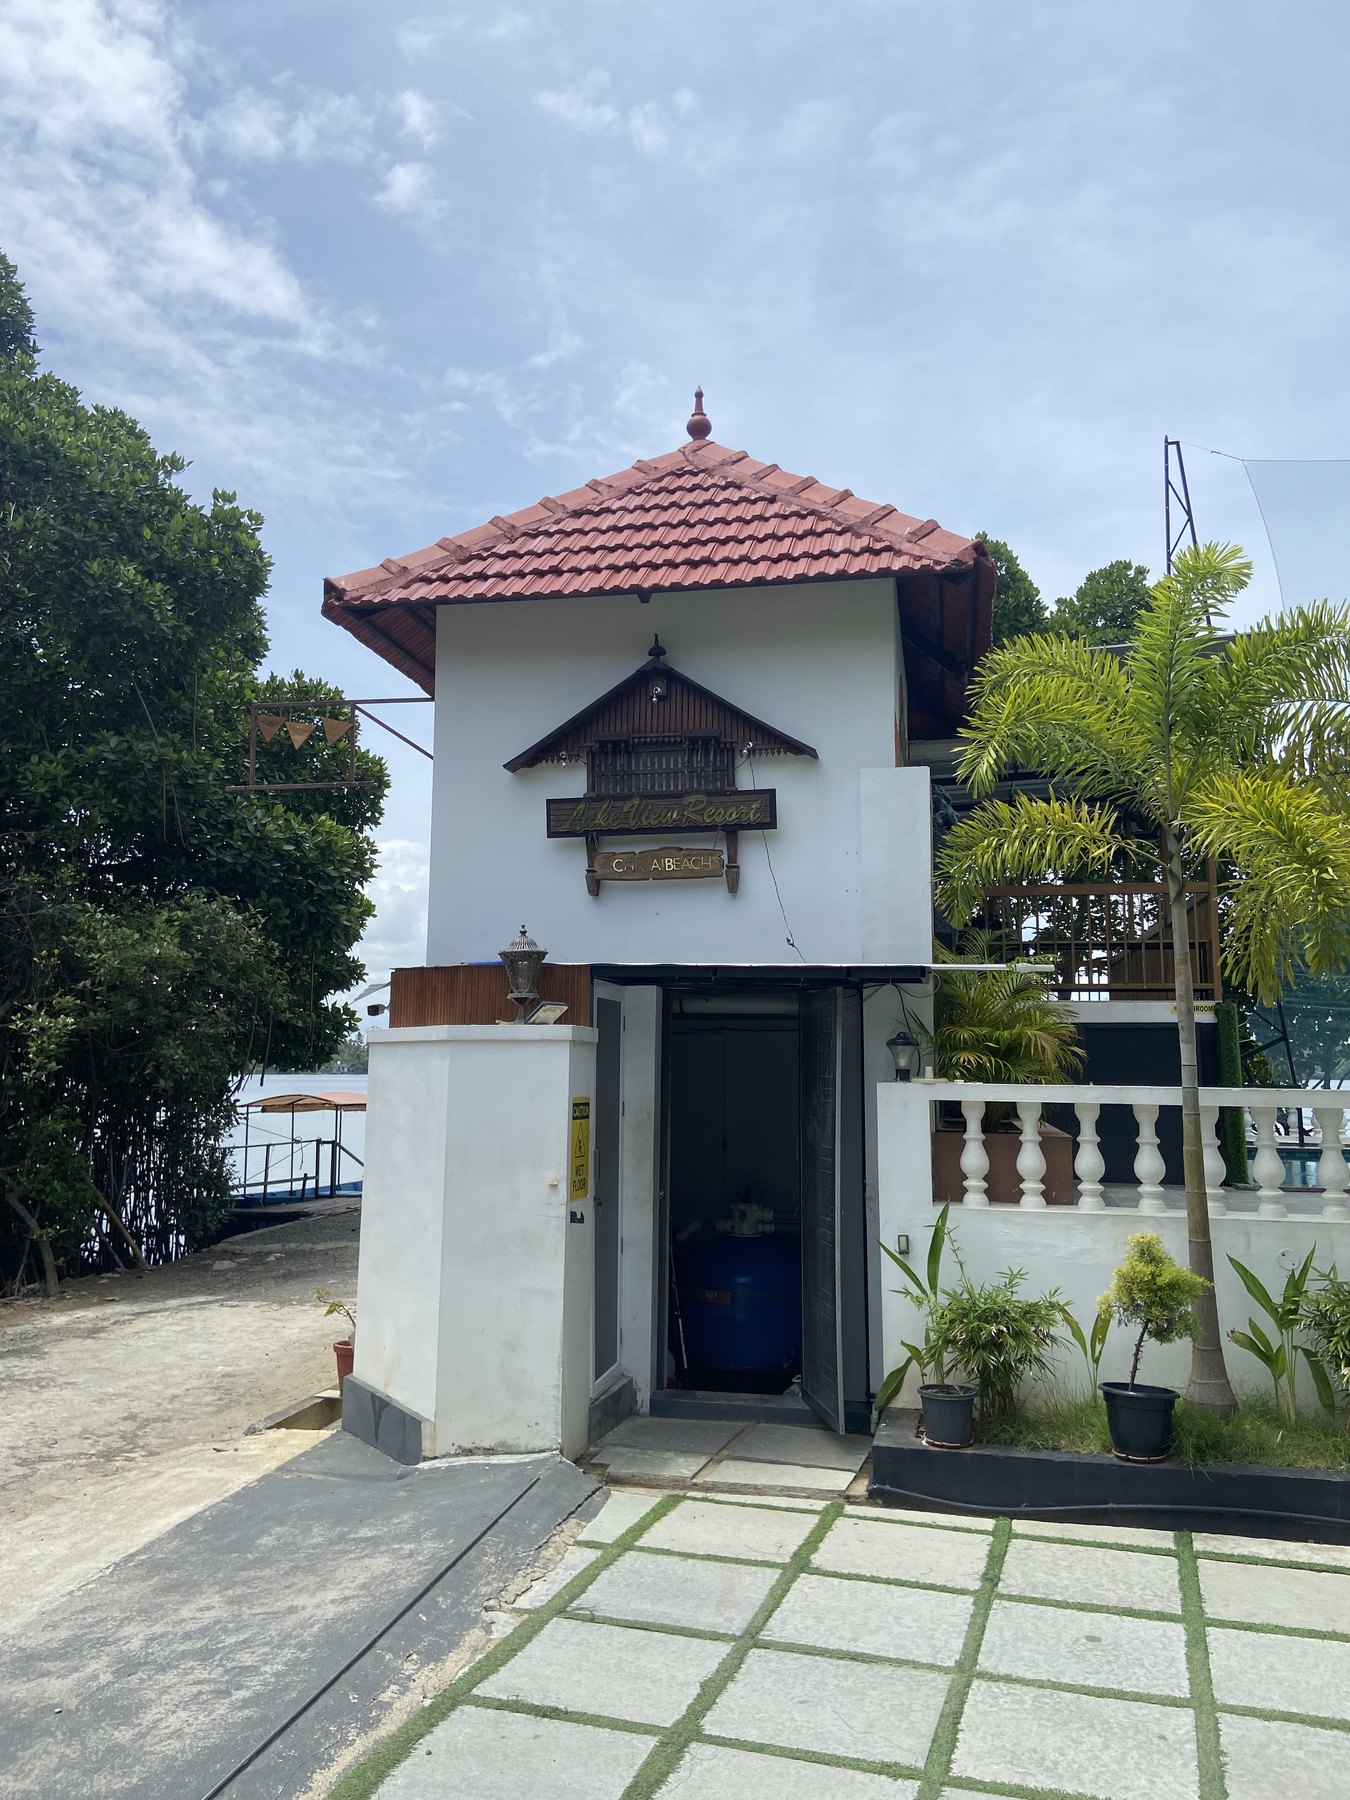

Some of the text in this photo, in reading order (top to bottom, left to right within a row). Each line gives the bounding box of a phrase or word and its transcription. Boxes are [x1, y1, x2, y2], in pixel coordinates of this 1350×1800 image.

[560, 795, 763, 832] Lake View Resort
[665, 856, 712, 872] BEACH
[575, 1164, 585, 1177] WET
[572, 1178, 586, 1192] FLOOR
